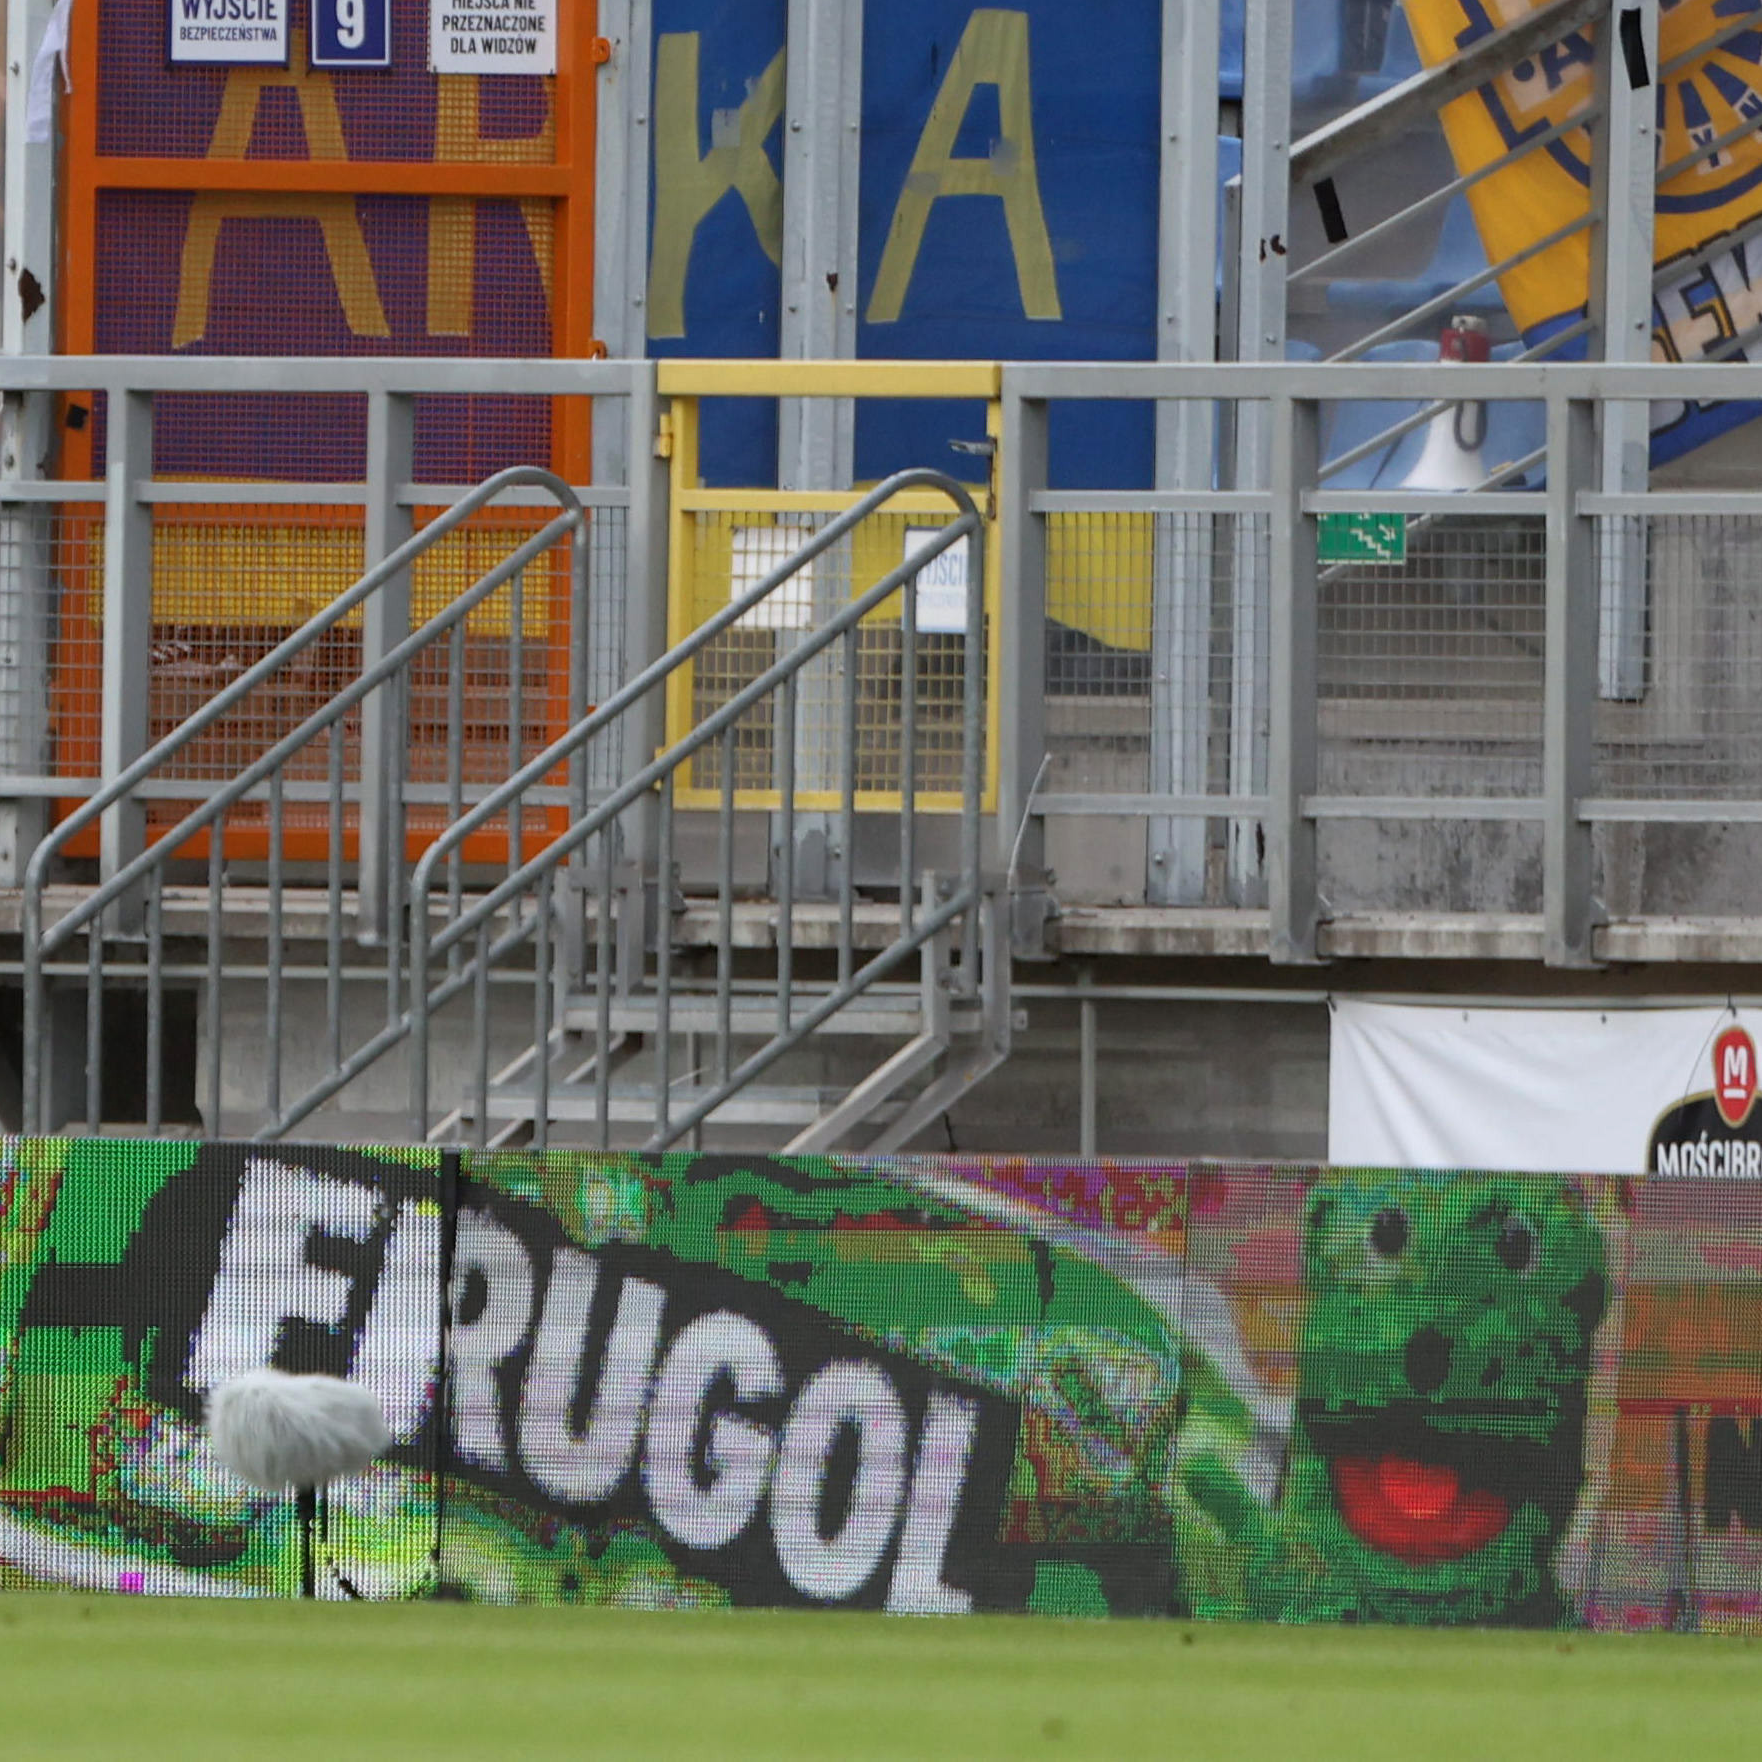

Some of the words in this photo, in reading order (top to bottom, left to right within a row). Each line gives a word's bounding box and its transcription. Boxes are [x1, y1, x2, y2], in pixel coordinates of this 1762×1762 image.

[179, 21, 278, 42] BEZPIECZEŃSTWA
[441, 14, 546, 34] PRZEZNACZONE
[450, 36, 476, 55] DLA
[481, 33, 538, 56] WIDZÓW
[1723, 1045, 1748, 1086] M
